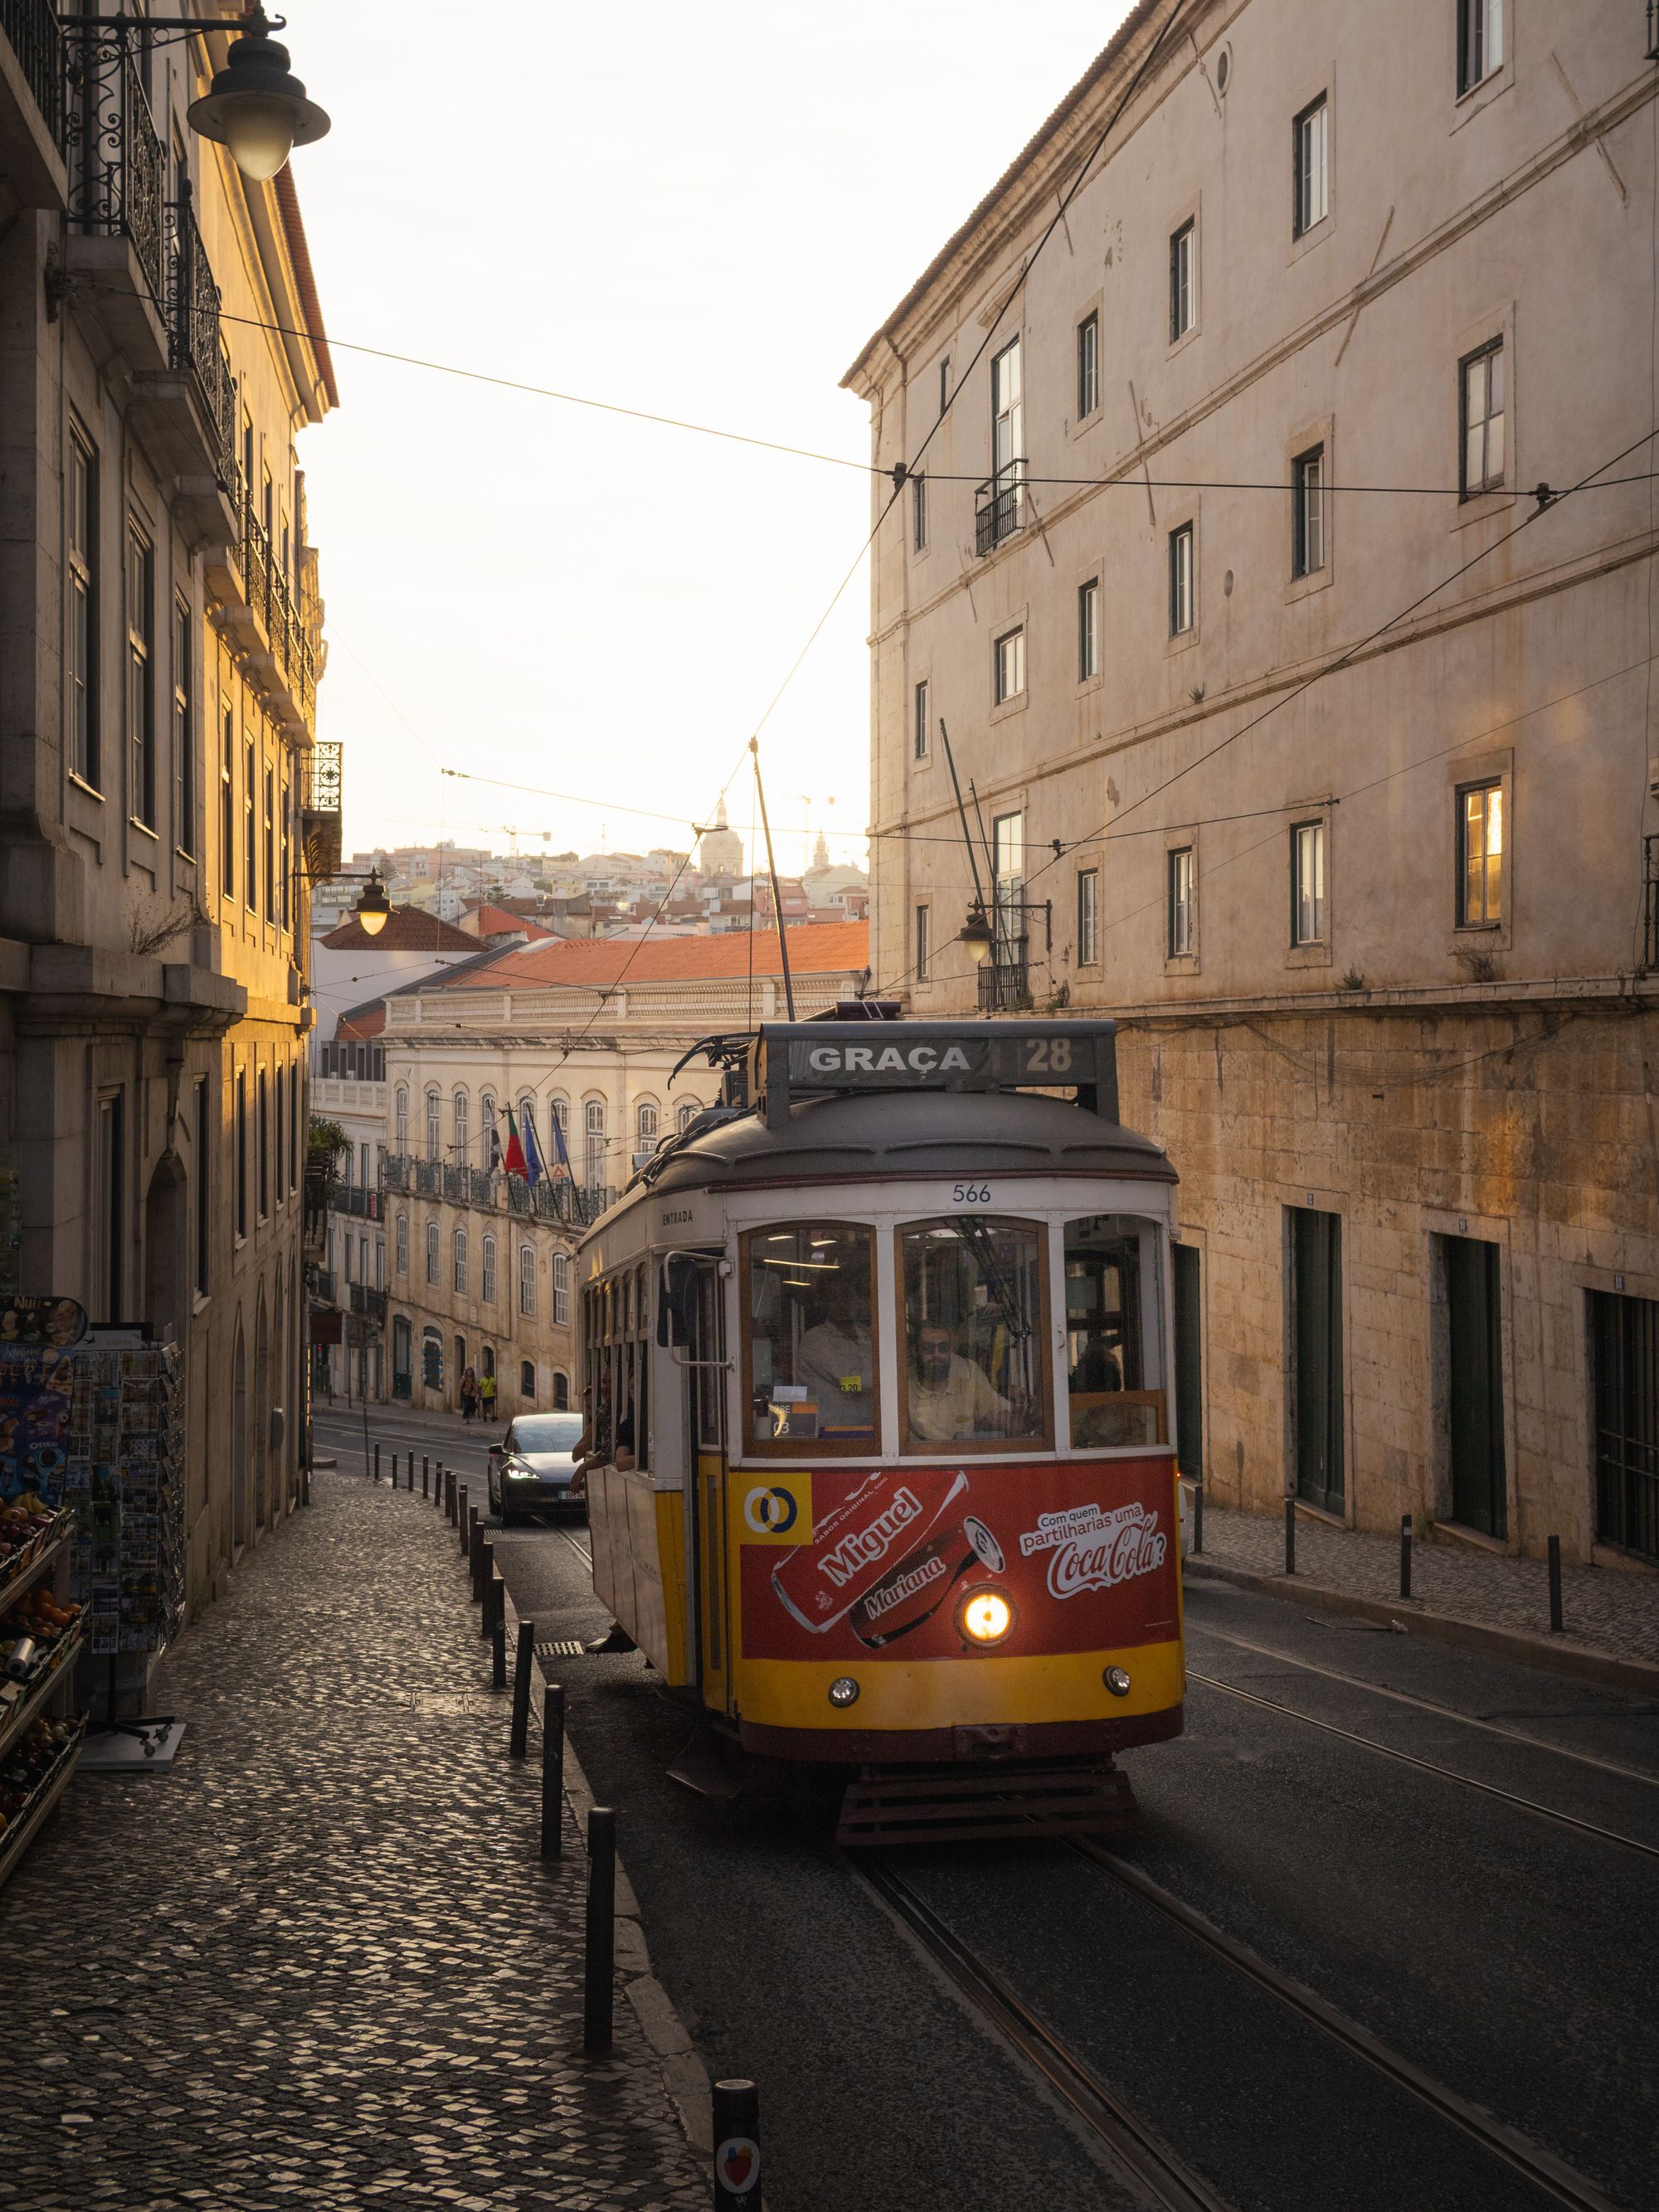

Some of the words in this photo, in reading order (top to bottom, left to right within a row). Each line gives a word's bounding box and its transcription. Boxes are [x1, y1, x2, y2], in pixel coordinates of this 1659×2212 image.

[809, 1047, 971, 1074] GRAÇA
[1026, 1038, 1073, 1072] 28
[952, 1184, 991, 1203] 566
[663, 1209, 693, 1227] ENTRADA
[815, 1520, 839, 1545] SABOR
[839, 1490, 874, 1521] ORIGINAL
[818, 1487, 923, 1586] Miguel
[1023, 1517, 1112, 1552] partilharias
[1115, 1505, 1142, 1524] uma
[1040, 1516, 1067, 1527] Com
[1069, 1506, 1097, 1521] quem
[864, 1556, 946, 1621] Mariana
